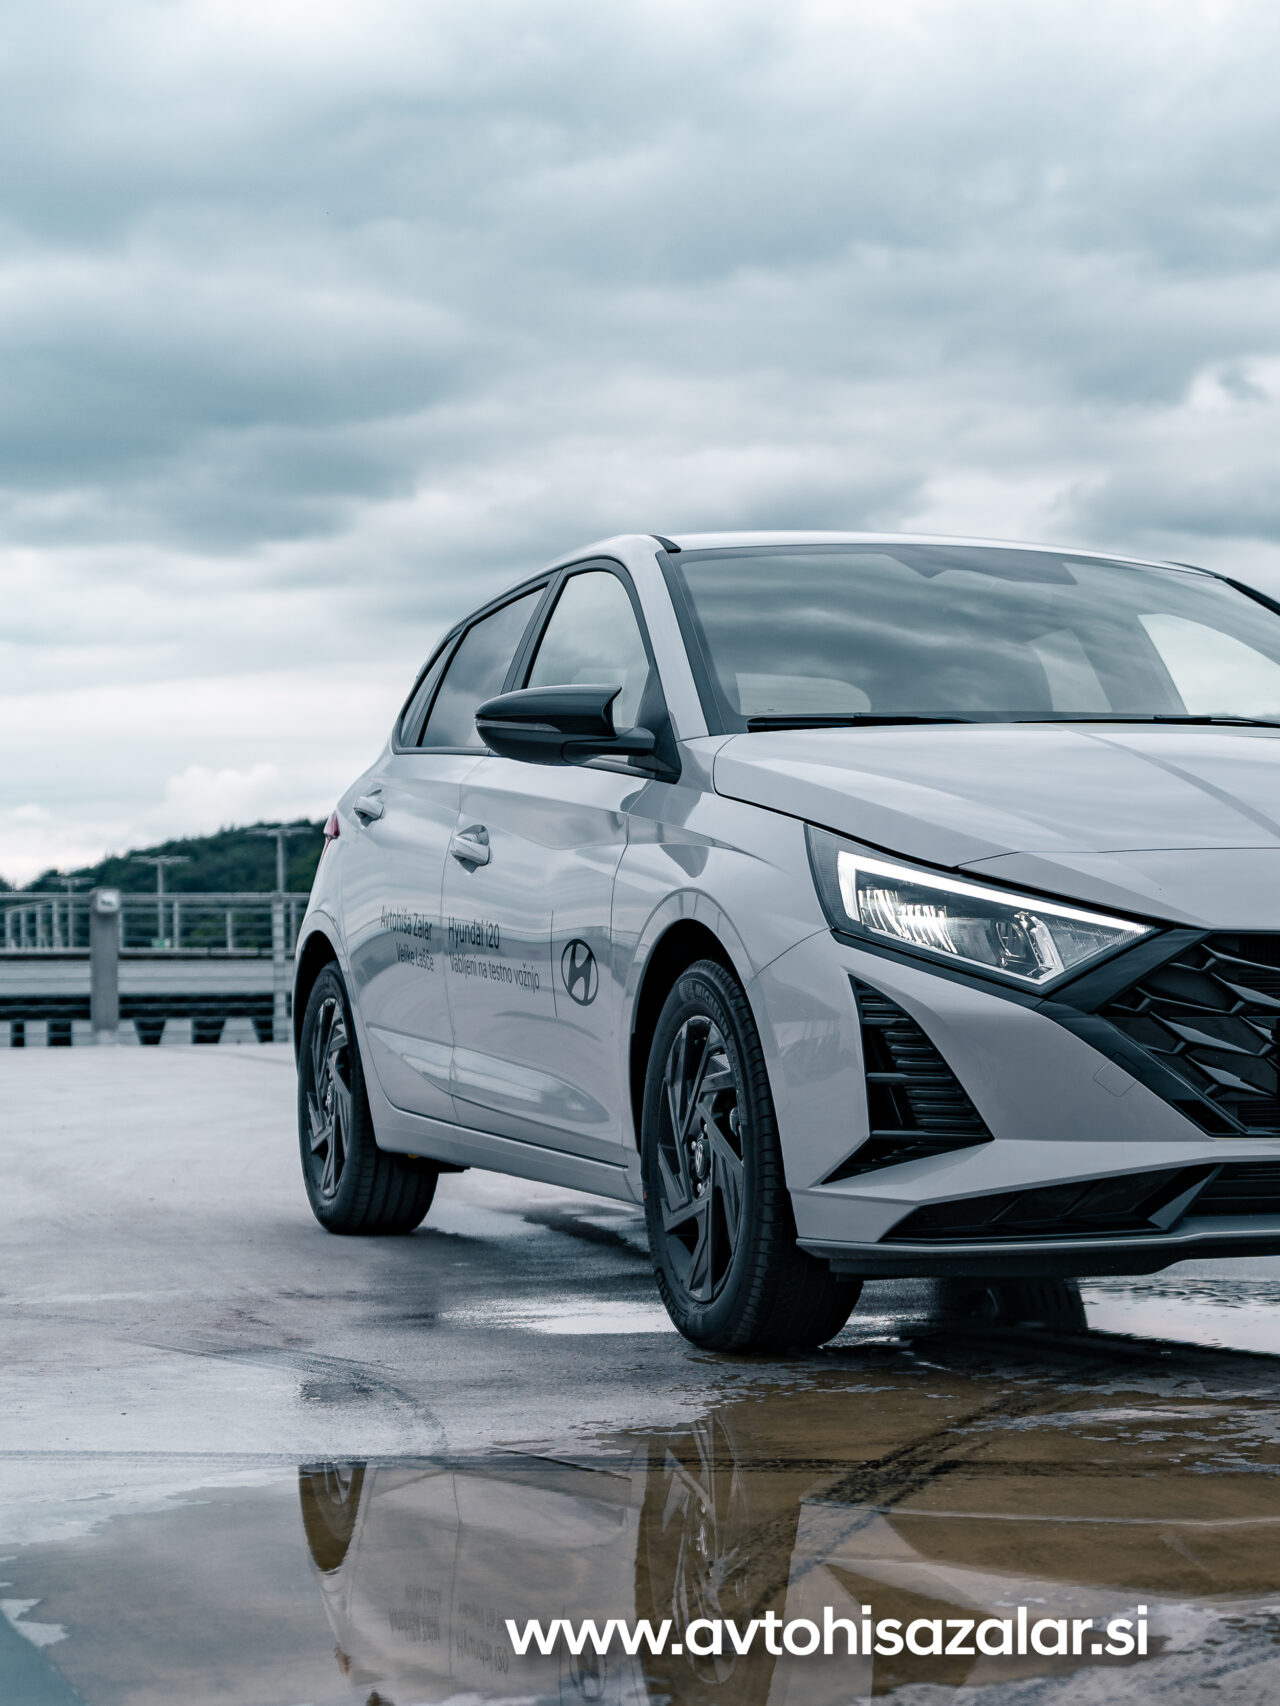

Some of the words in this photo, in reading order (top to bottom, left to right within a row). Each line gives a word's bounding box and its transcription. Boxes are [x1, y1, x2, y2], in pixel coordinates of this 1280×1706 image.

[380, 905, 412, 935] Avtohiša
[413, 913, 433, 941] Zalar
[448, 916, 484, 949] Hyundai
[485, 920, 500, 950] i20
[449, 951, 478, 979] Vabljeni
[478, 961, 488, 979] na
[488, 960, 513, 984] testno
[514, 963, 540, 994] vožnjo
